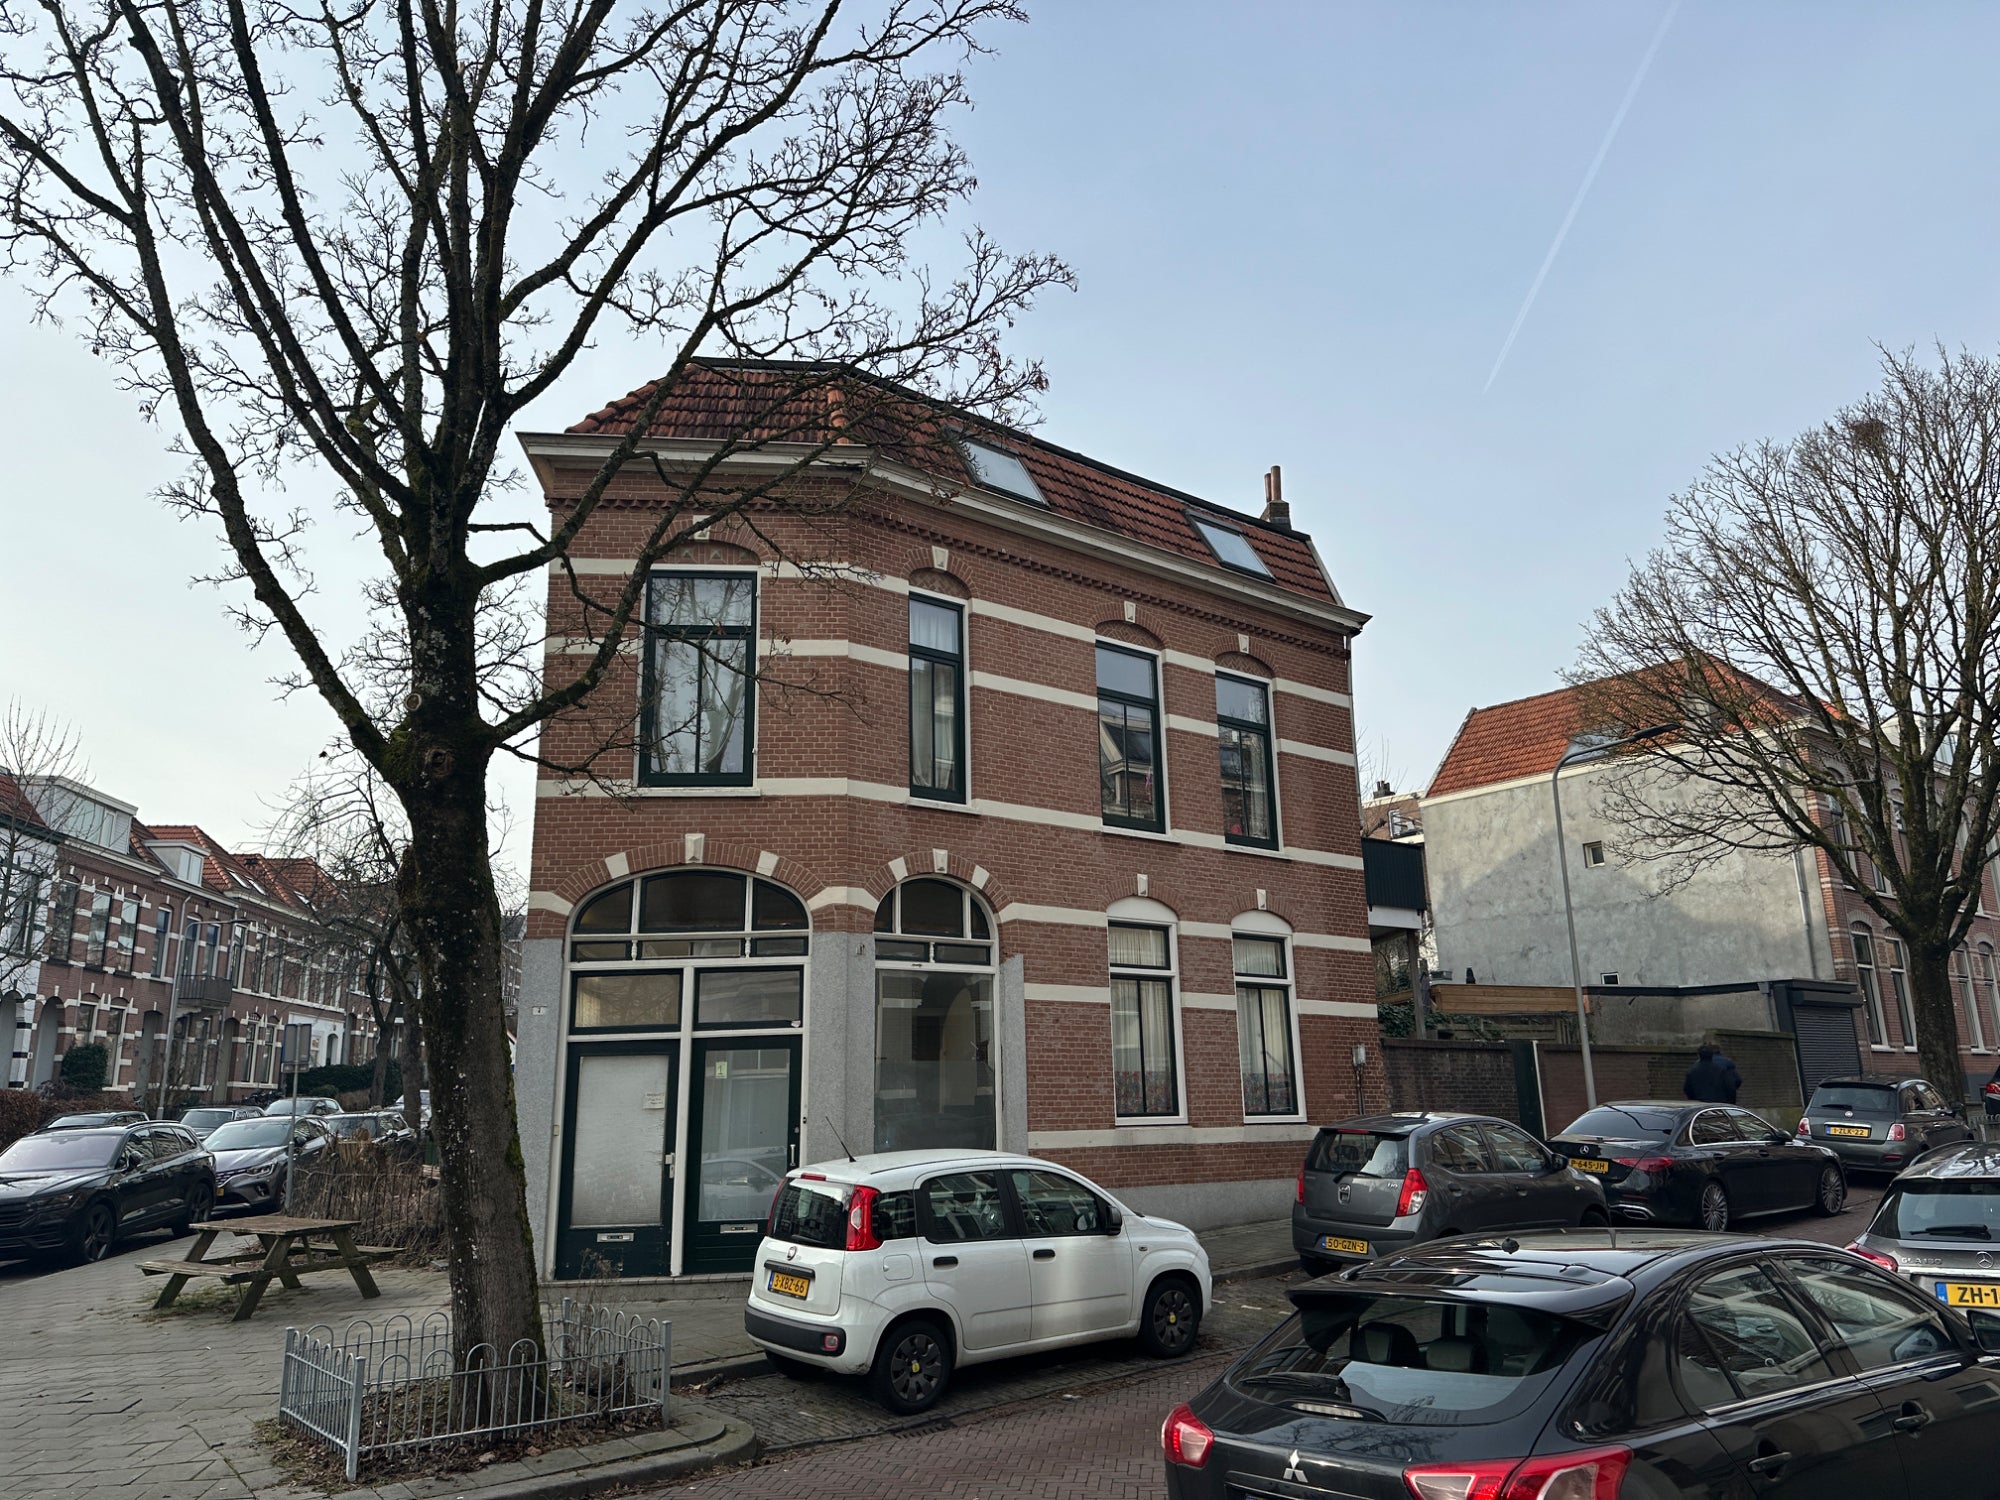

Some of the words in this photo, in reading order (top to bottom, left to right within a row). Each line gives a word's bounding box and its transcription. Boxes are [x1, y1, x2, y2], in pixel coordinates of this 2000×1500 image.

[1327, 1238, 1365, 1252] 50-GZN-3
[773, 1274, 805, 1294] 3-XBZ-66
[1957, 1286, 2000, 1305] ZH-1
